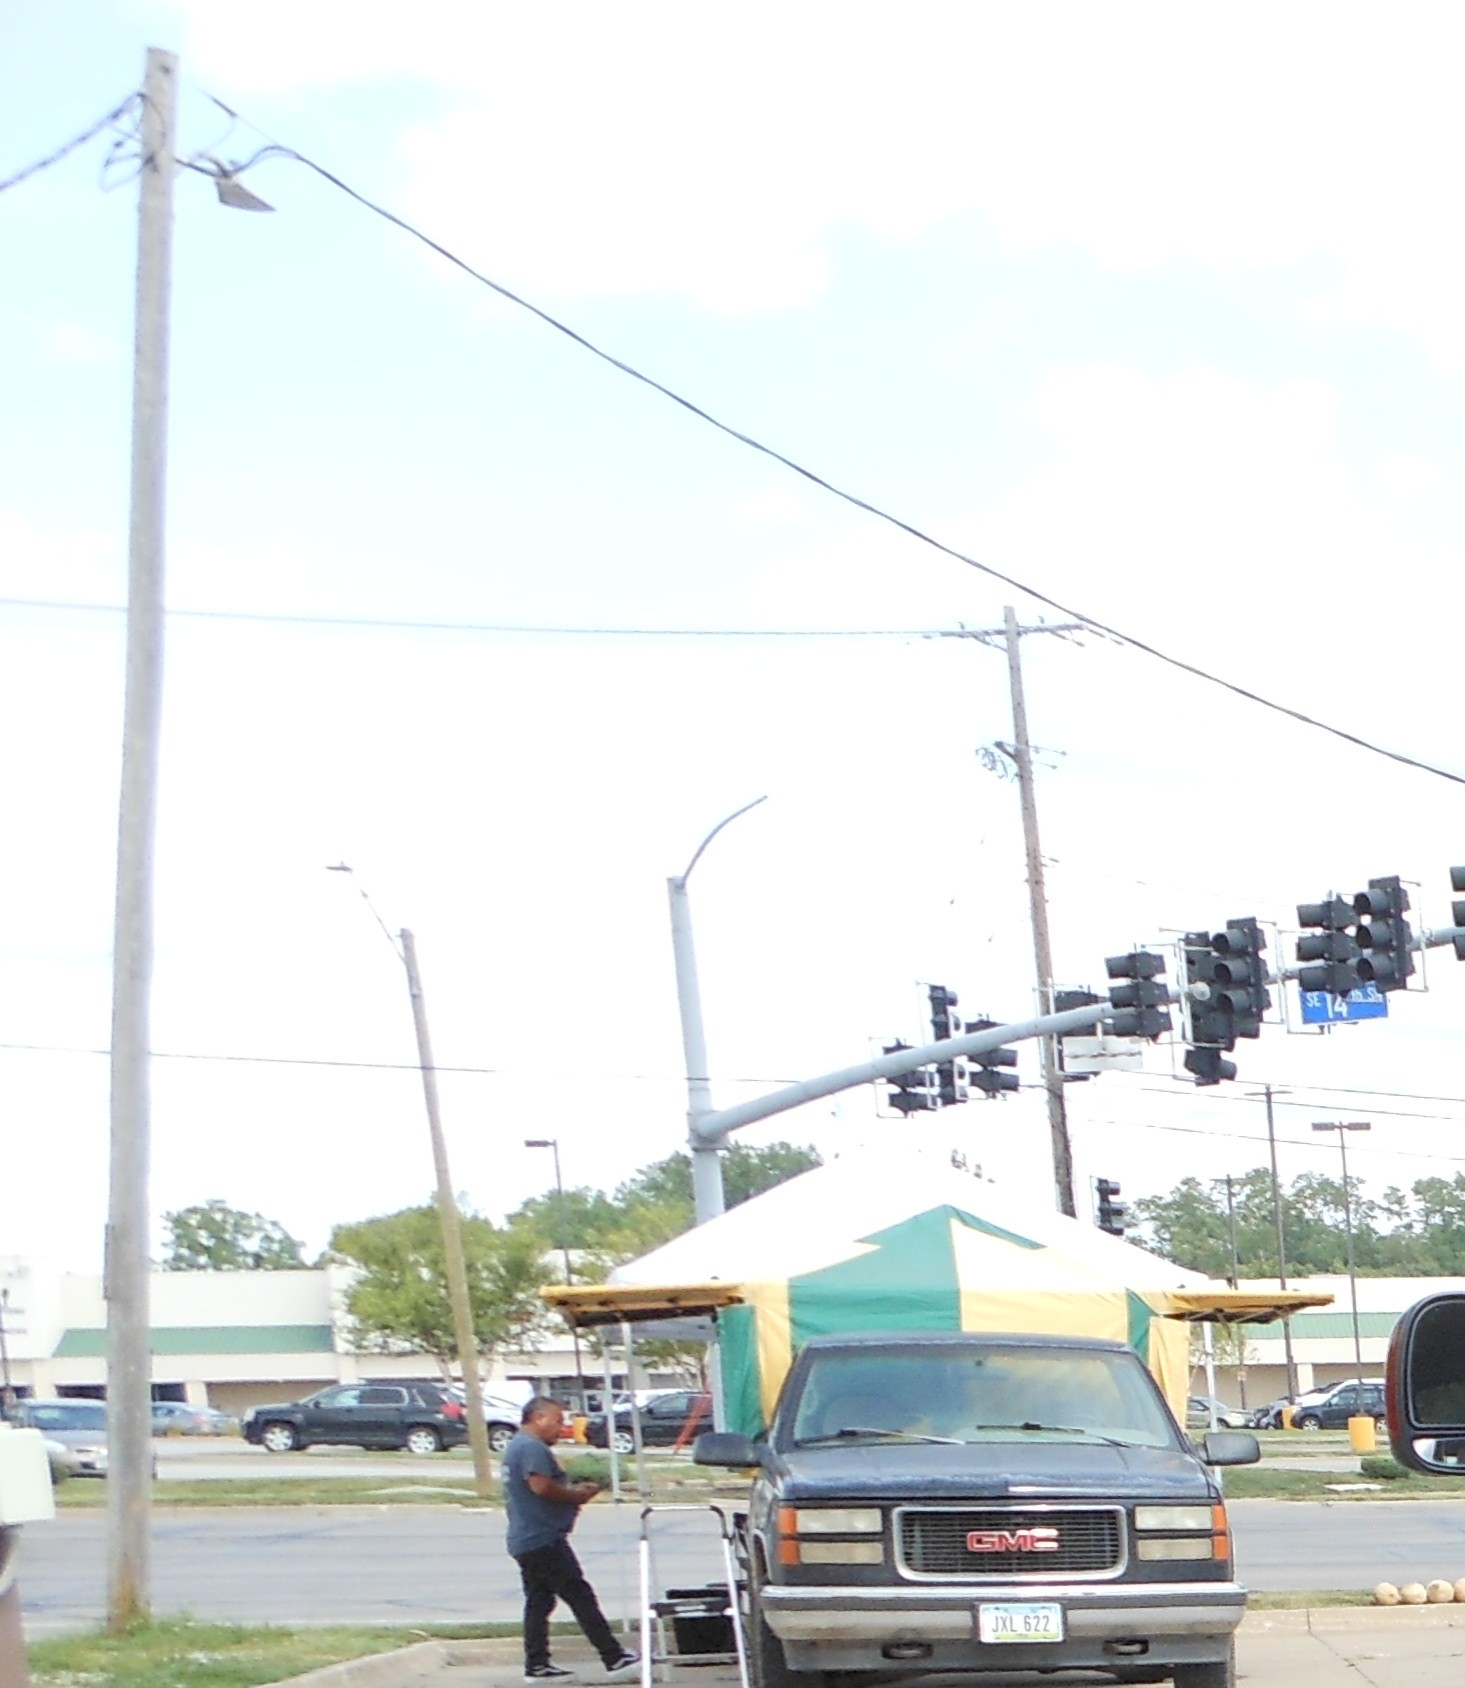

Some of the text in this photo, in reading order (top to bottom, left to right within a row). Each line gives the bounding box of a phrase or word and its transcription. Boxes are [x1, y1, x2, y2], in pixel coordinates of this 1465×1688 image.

[1306, 992, 1322, 1008] SE
[967, 1528, 1059, 1551] GMC
[992, 1615, 1050, 1632] JXL 622
